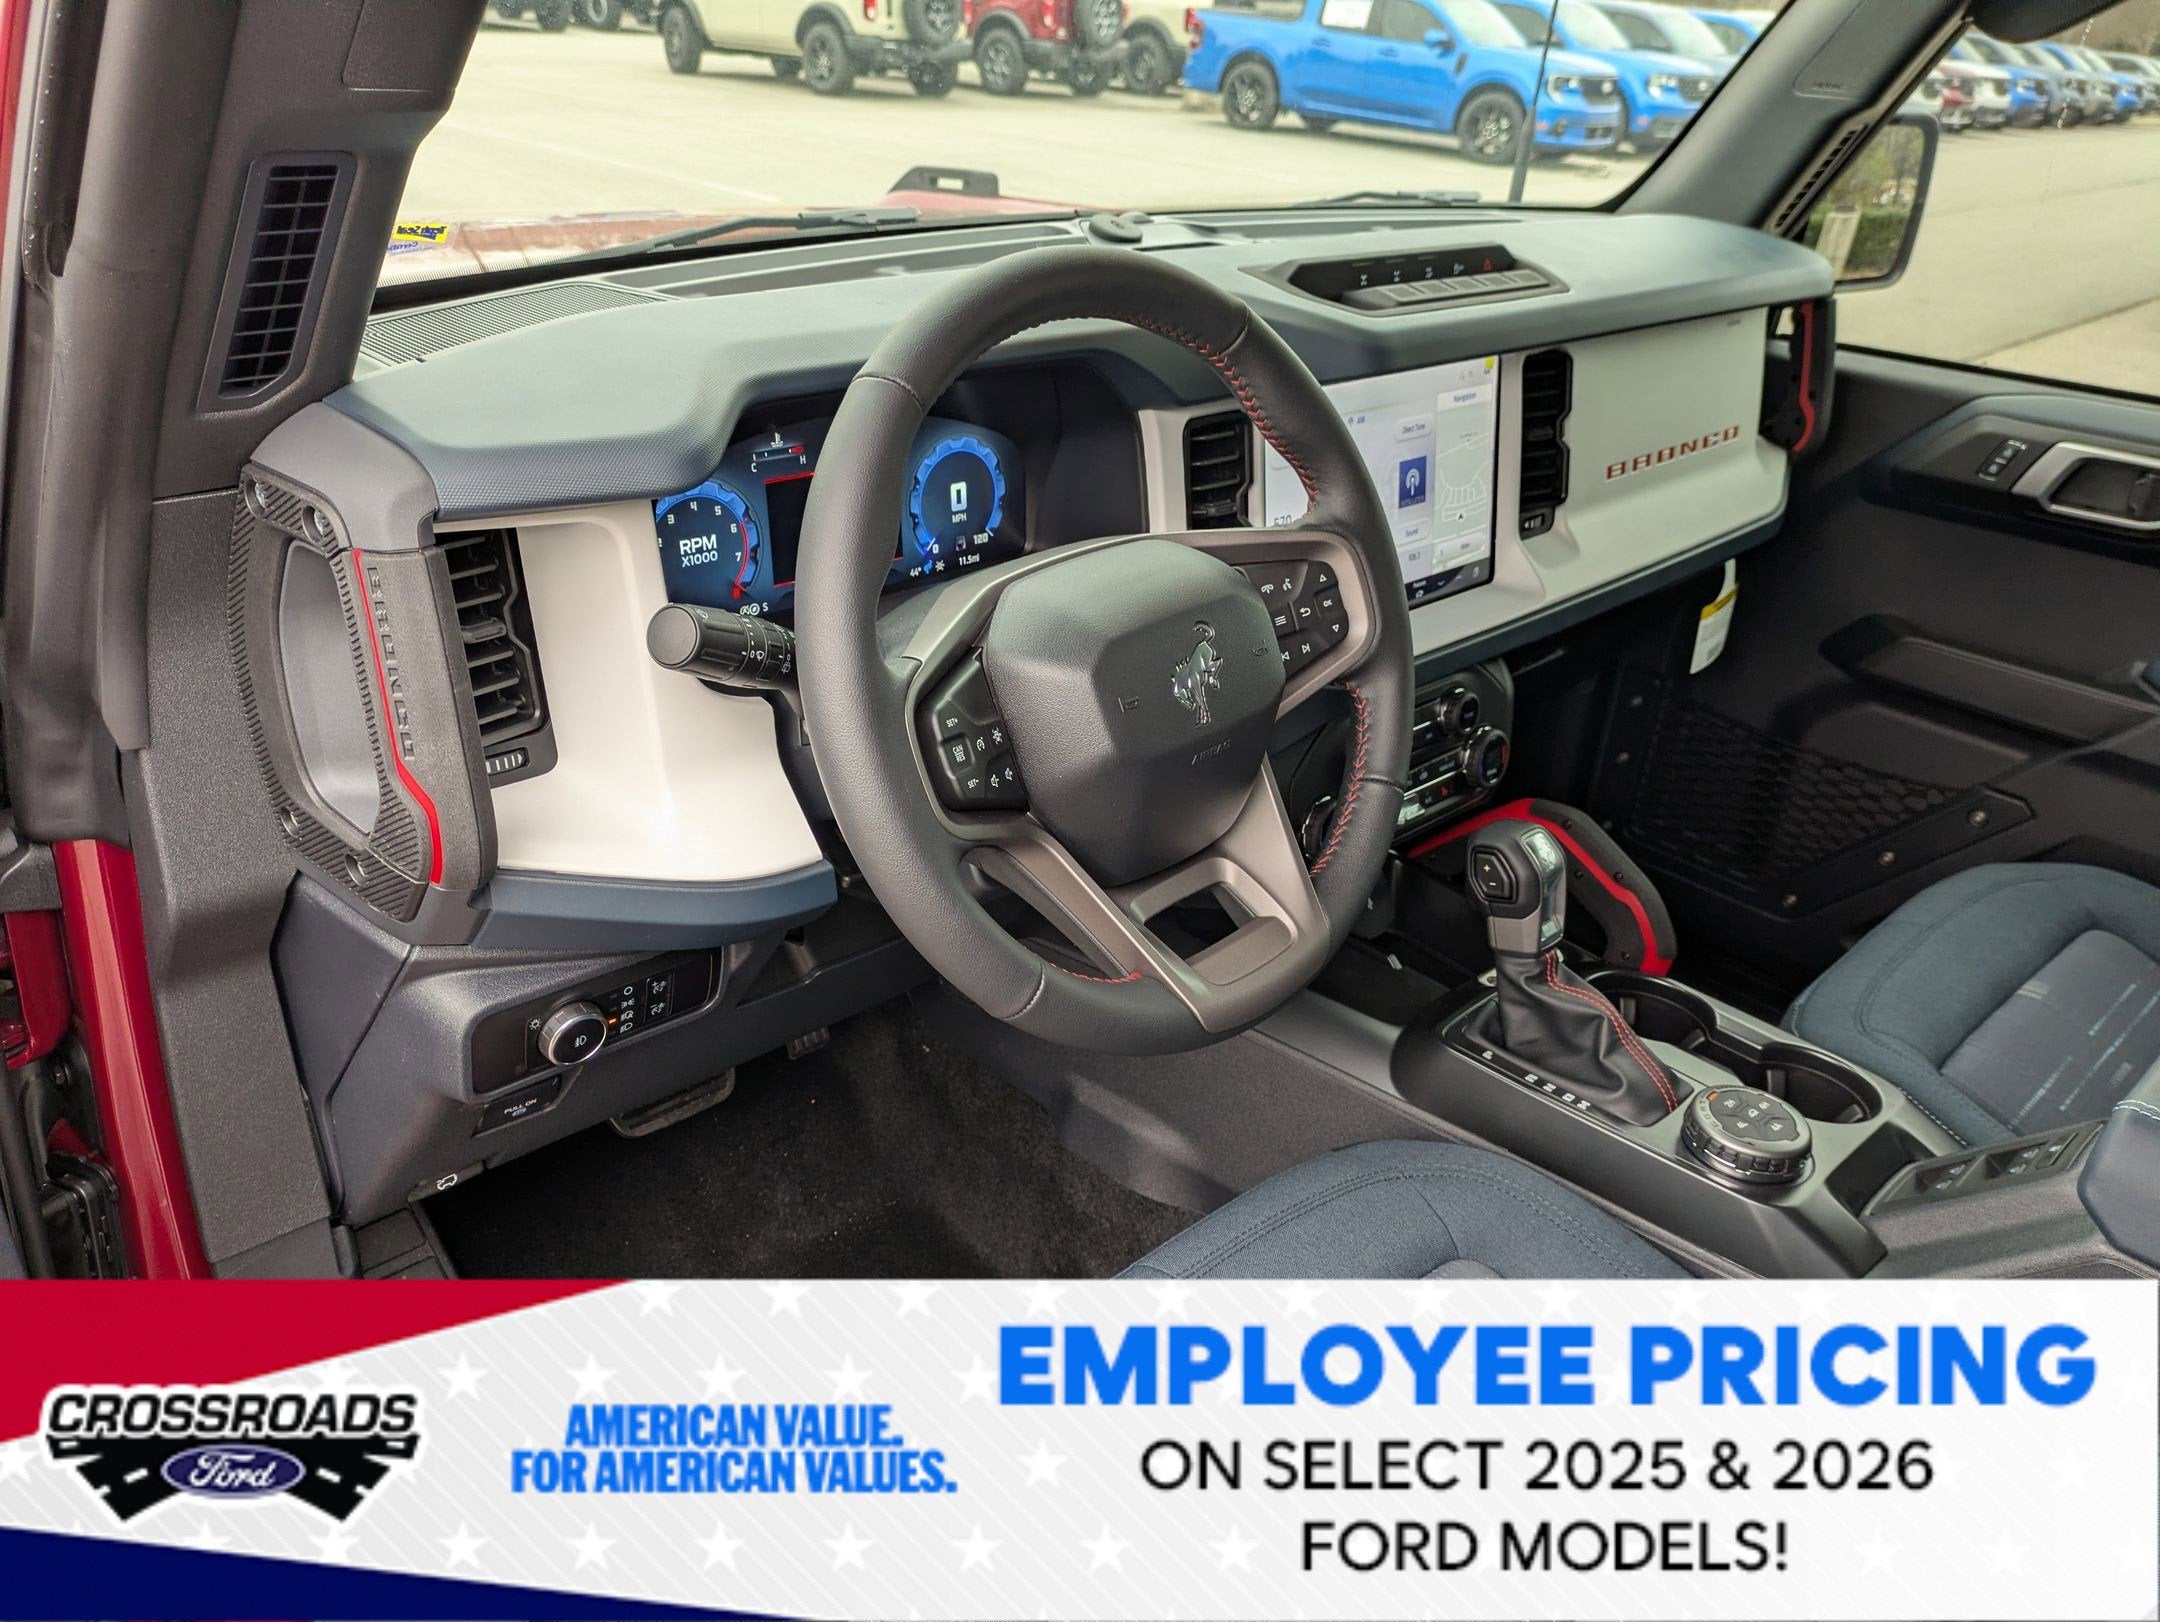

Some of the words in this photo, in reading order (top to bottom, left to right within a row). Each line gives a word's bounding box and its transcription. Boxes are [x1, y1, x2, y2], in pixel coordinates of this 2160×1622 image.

[1605, 423, 1739, 481] BRONCO
[799, 454, 807, 465] H
[750, 462, 758, 473] C
[950, 481, 968, 512] 0
[690, 501, 698, 511] 4
[714, 505, 722, 516] 5
[667, 514, 675, 524] 3
[951, 512, 967, 524] MPH
[730, 523, 738, 534] 6
[973, 532, 989, 545] 120
[679, 534, 718, 556] RPM
[932, 543, 939, 554] 0
[681, 551, 718, 568] X1000
[734, 551, 742, 562] 7
[762, 602, 769, 612] S
[525, 1098, 537, 1107] ON
